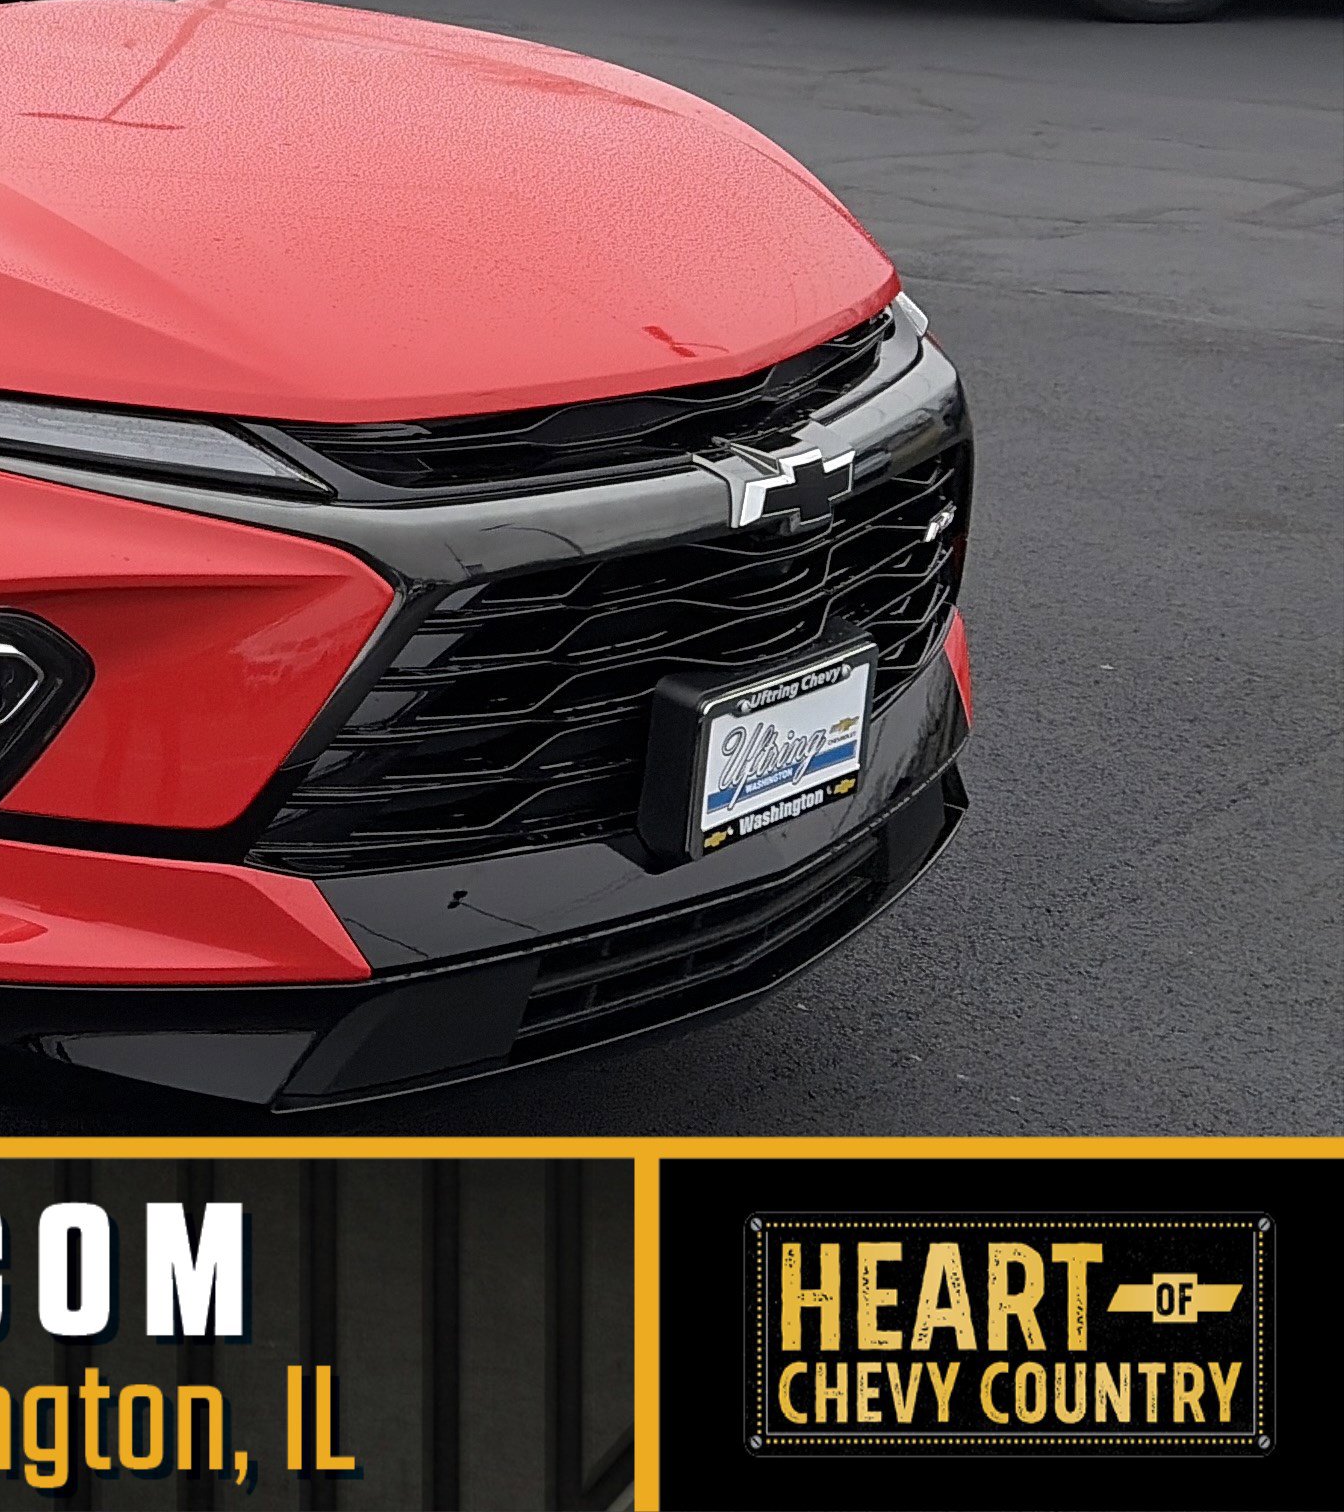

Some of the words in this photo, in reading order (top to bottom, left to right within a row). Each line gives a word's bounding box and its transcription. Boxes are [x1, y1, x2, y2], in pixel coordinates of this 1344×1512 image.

[749, 679, 800, 710] Uftring
[801, 666, 842, 692] Chevy
[717, 722, 827, 811] Uftring
[744, 769, 793, 795] WASHINGTON
[738, 788, 824, 836] Washington
